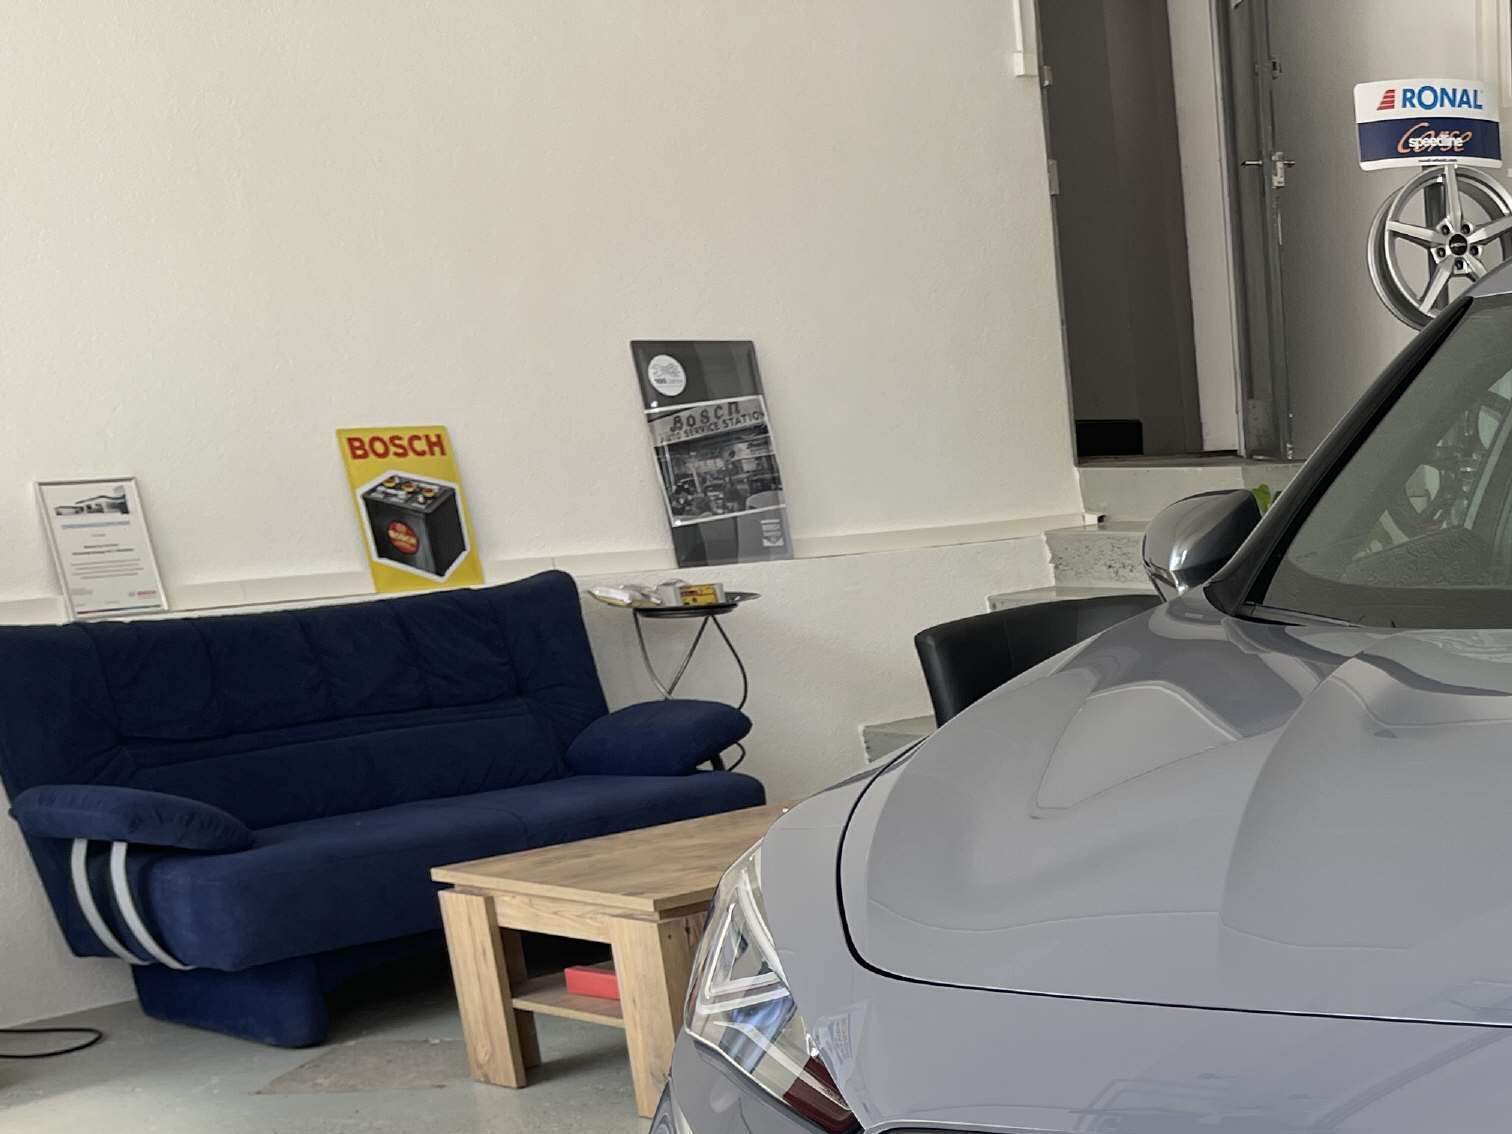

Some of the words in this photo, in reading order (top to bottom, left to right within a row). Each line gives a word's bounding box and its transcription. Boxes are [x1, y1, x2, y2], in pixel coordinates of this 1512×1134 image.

[1402, 85, 1483, 111] RONAL
[670, 401, 741, 433] BOSCH
[346, 432, 447, 460] BOSCH
